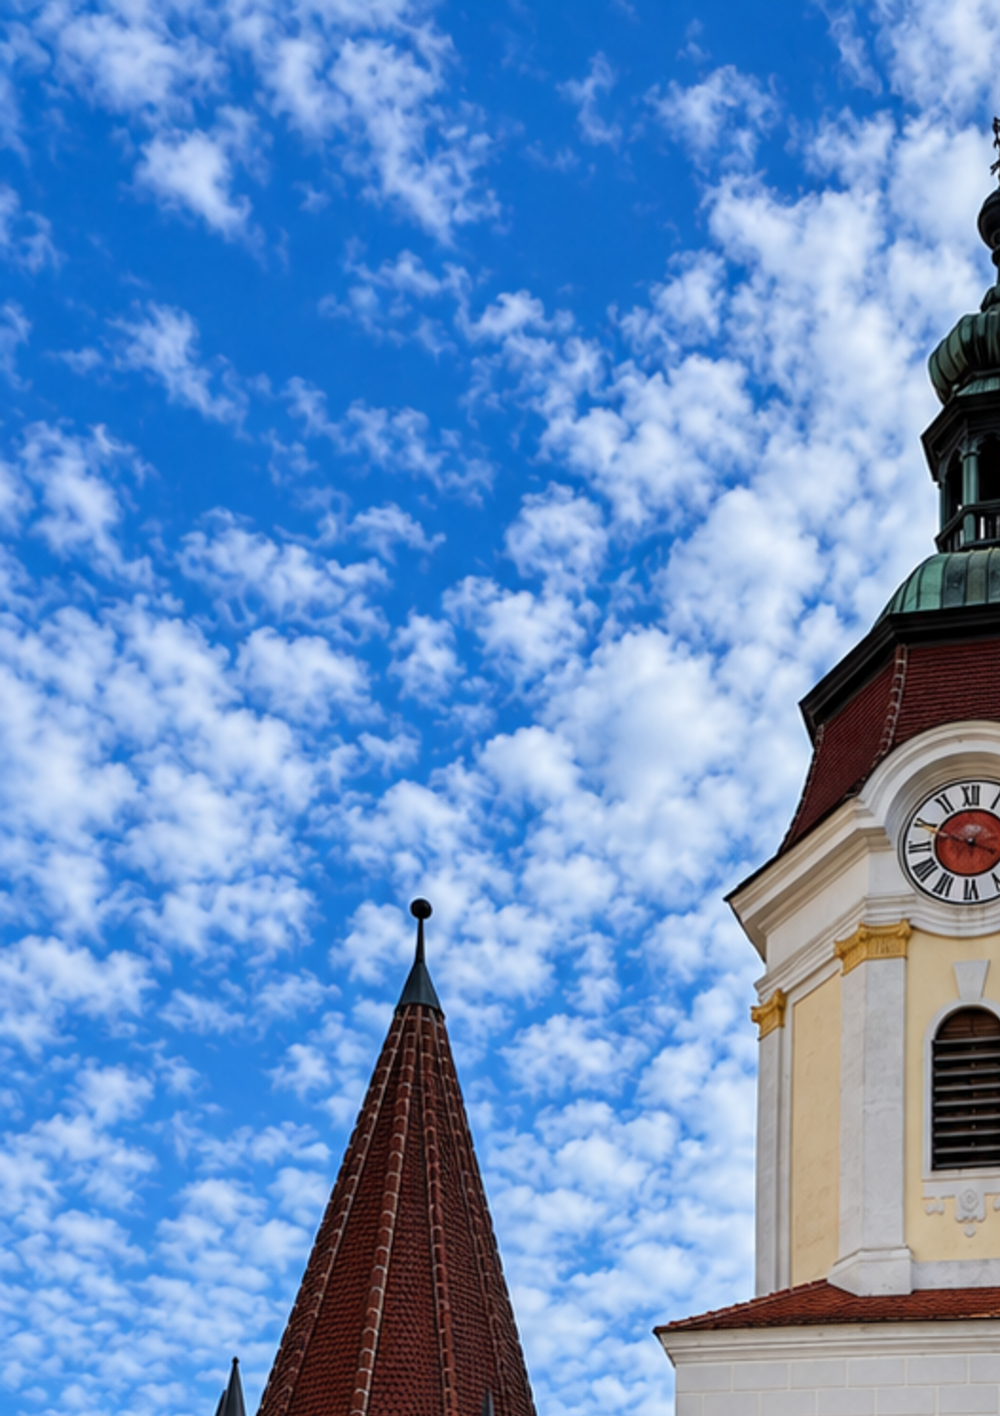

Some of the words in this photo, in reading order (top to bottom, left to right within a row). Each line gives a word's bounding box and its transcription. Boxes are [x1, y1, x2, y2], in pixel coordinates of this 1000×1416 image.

[961, 785, 981, 806] XII
[932, 873, 954, 897] VII
[963, 879, 979, 900] VI
